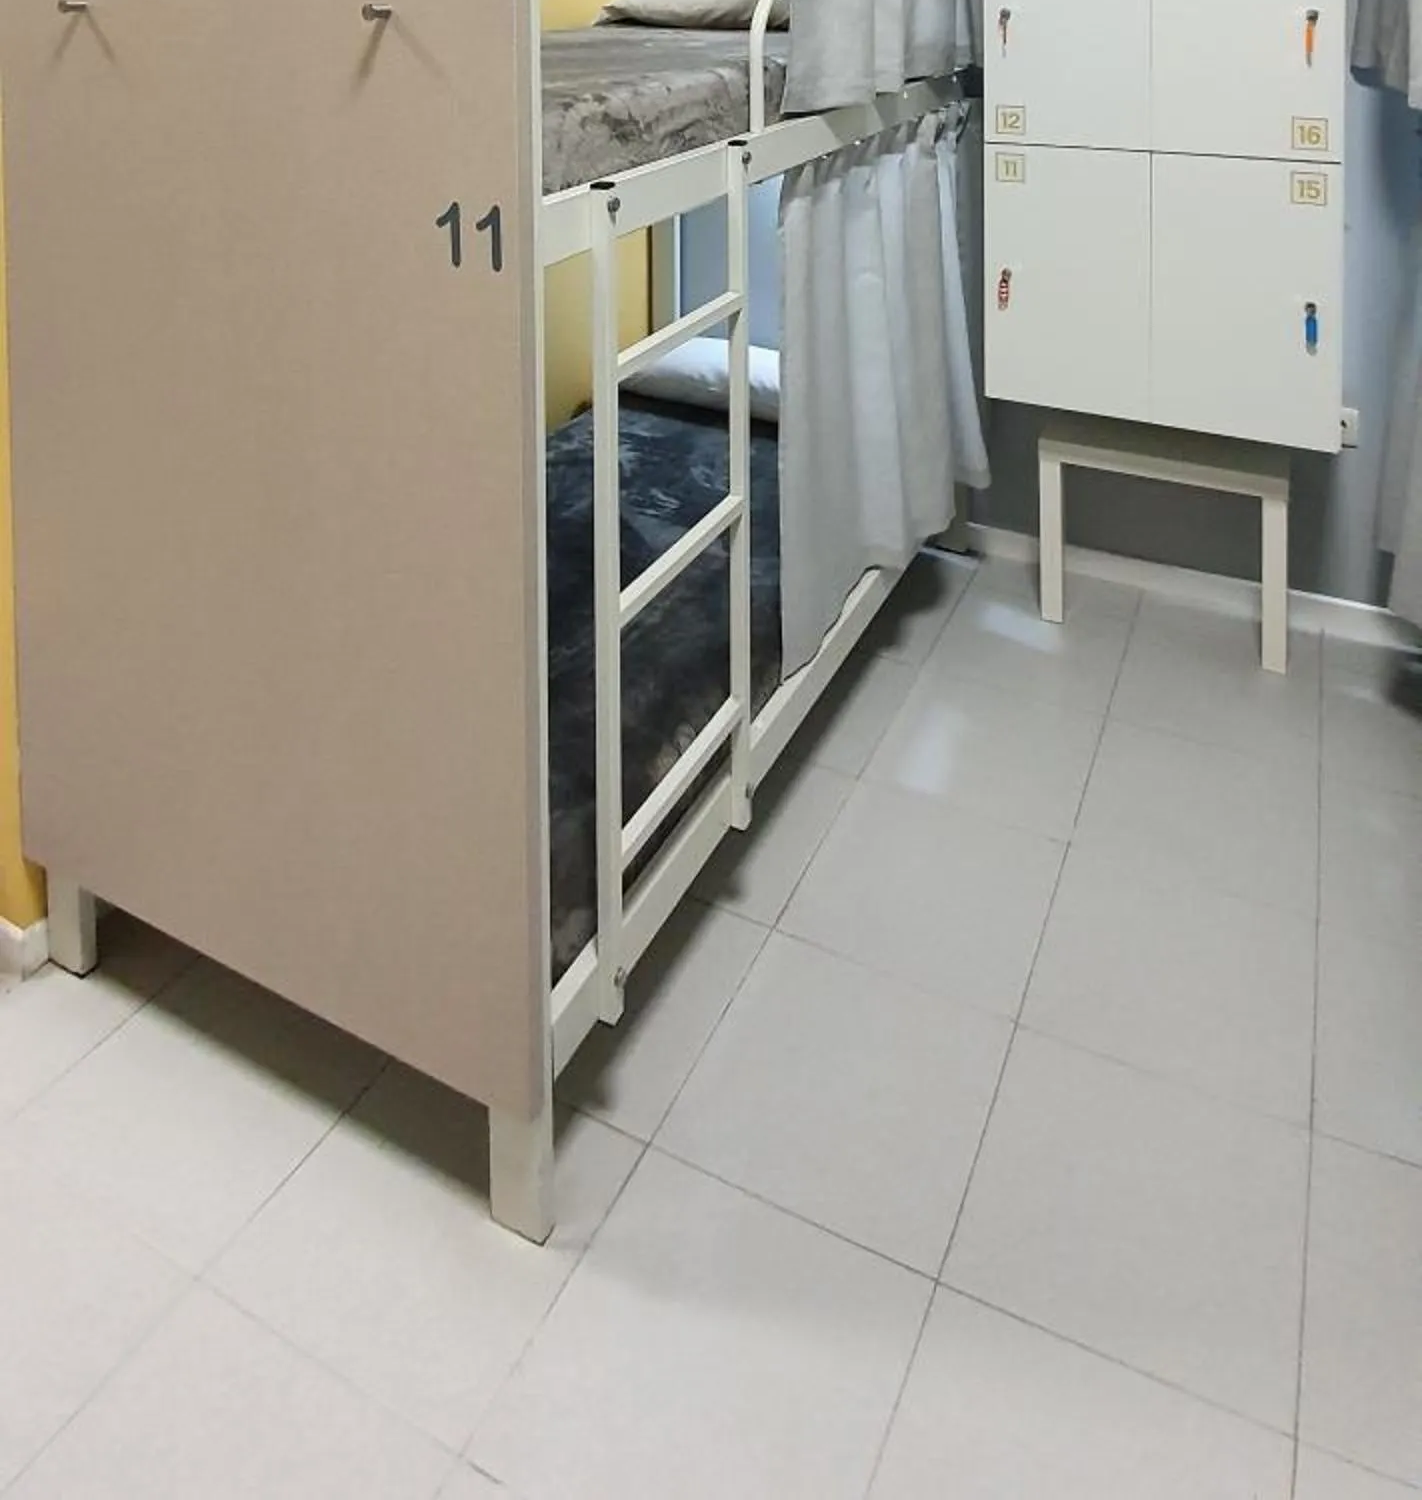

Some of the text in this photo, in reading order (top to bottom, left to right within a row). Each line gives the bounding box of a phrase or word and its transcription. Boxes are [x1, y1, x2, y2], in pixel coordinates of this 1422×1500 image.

[1000, 112, 1021, 129] 12
[1296, 125, 1321, 145] 16
[1296, 179, 1321, 199] 15
[435, 201, 503, 273] 11
